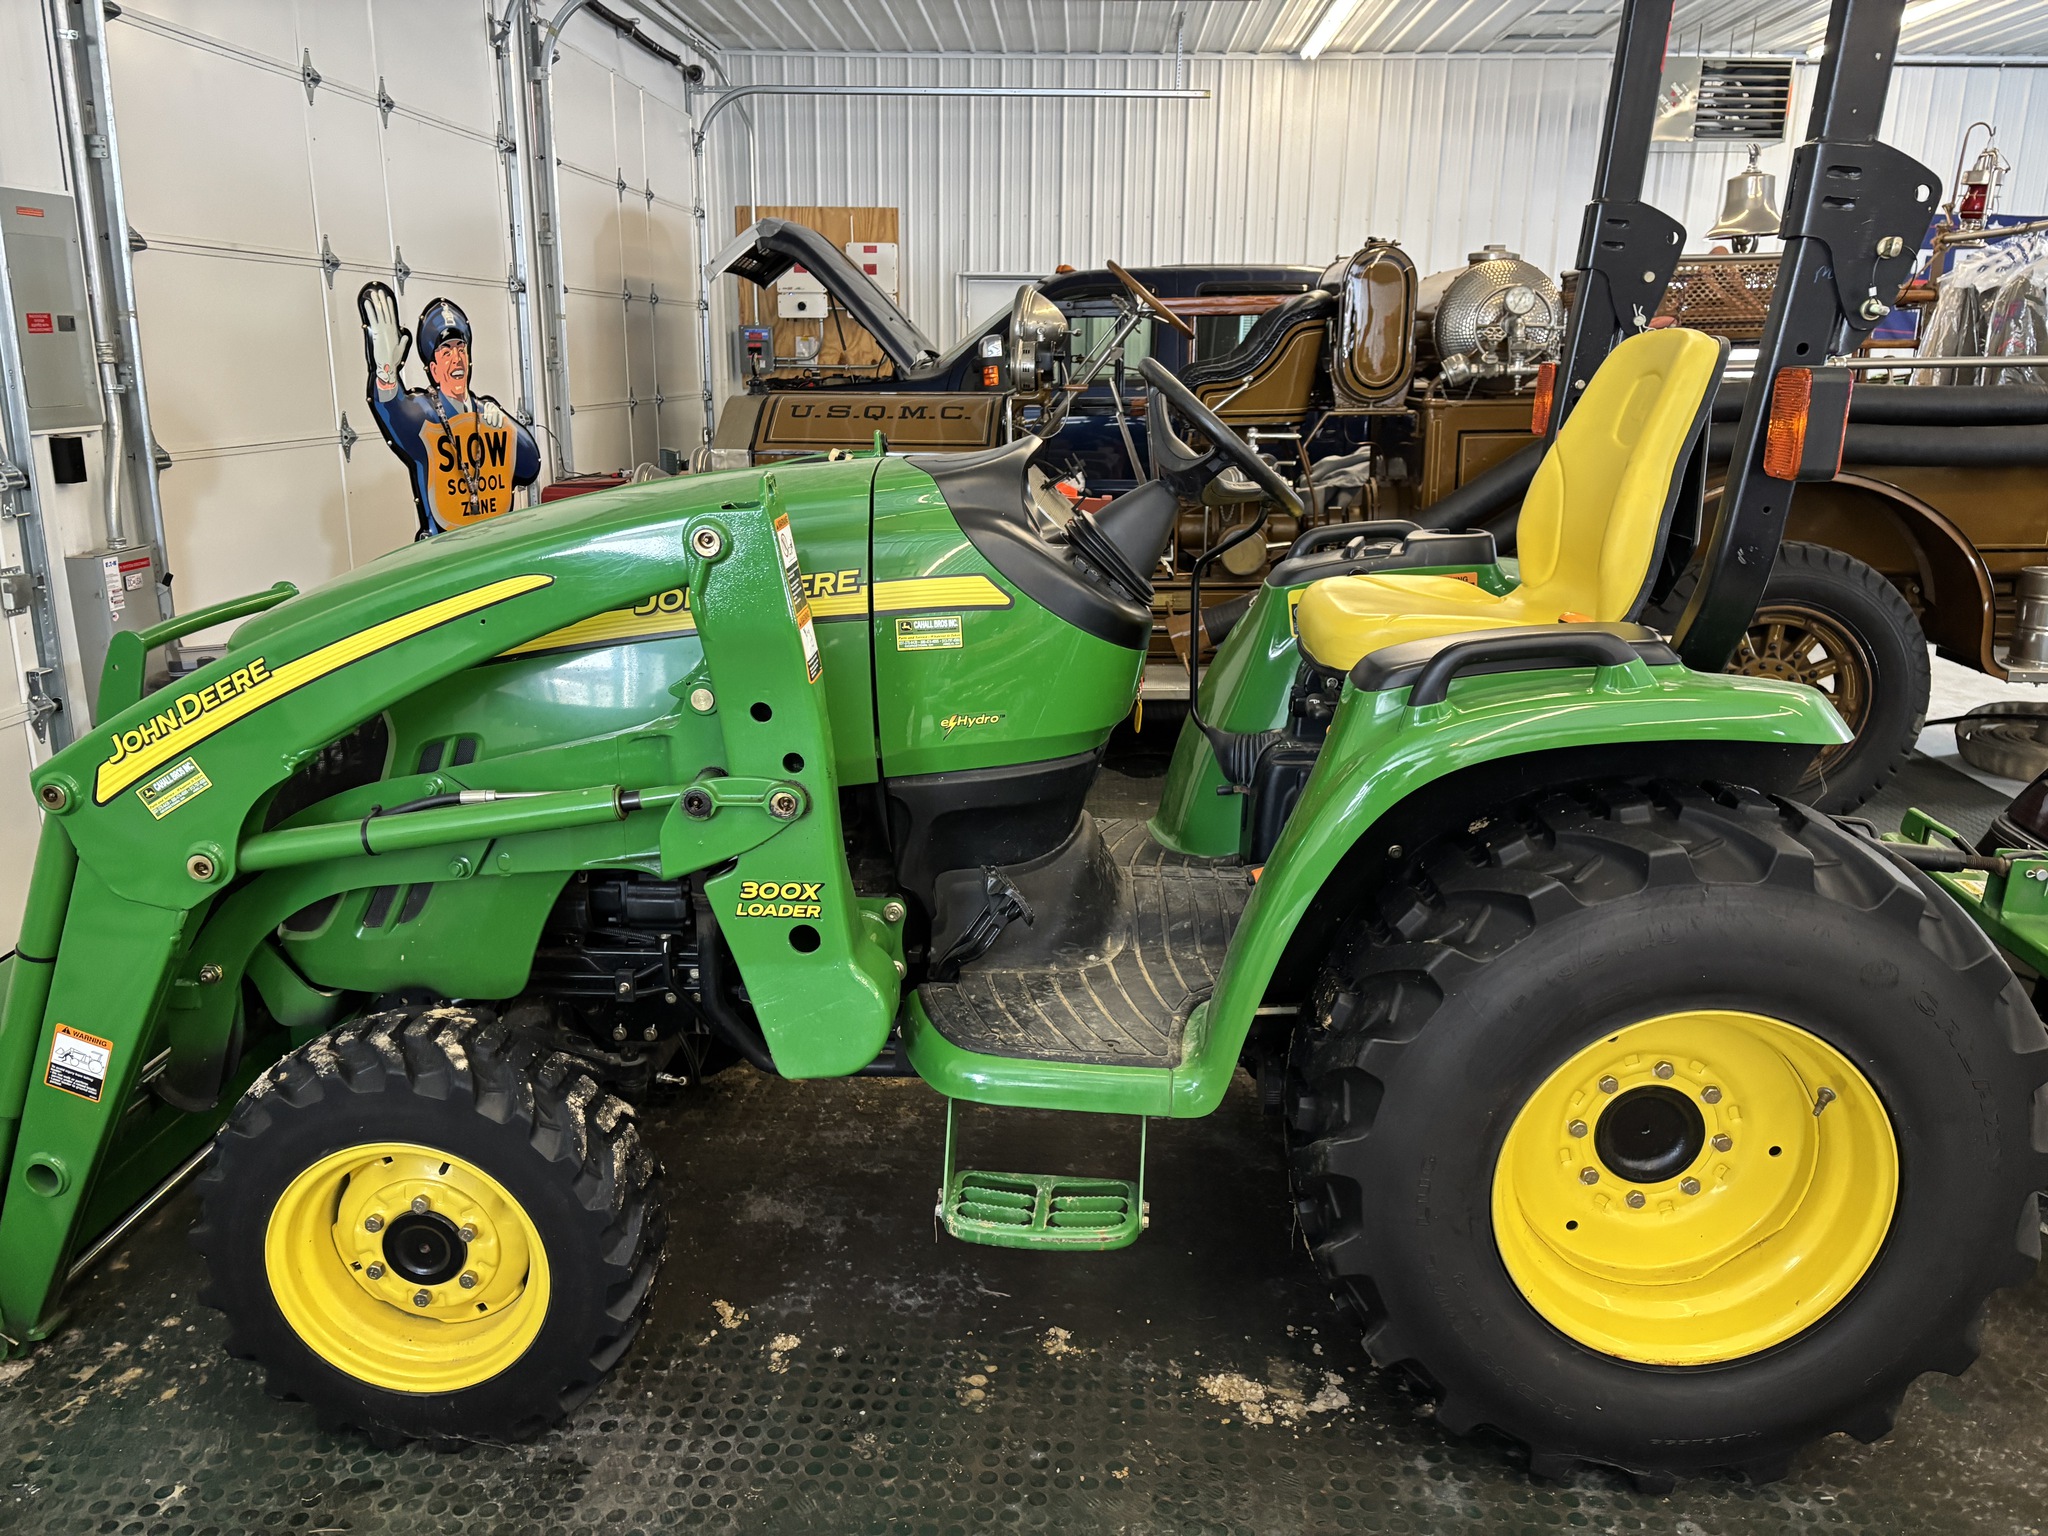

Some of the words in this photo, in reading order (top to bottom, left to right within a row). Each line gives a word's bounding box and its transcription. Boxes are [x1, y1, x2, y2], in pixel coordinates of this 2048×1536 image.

[791, 405, 971, 420] U.S.Q.M.C.
[437, 431, 507, 472] SLOW
[447, 474, 505, 495] SCOOL
[461, 498, 497, 516] ZNE
[634, 586, 690, 617] JO
[800, 568, 862, 597] ERE
[913, 620, 933, 629] CAHALL
[934, 619, 948, 628] BROS
[108, 707, 181, 765] JOHN
[175, 656, 272, 725] DEERE
[152, 775, 173, 792] CAHALL
[170, 766, 186, 780] BROS
[740, 881, 824, 902] 300X
[735, 903, 822, 919] LOADER
[73, 1030, 107, 1048] WARNING
